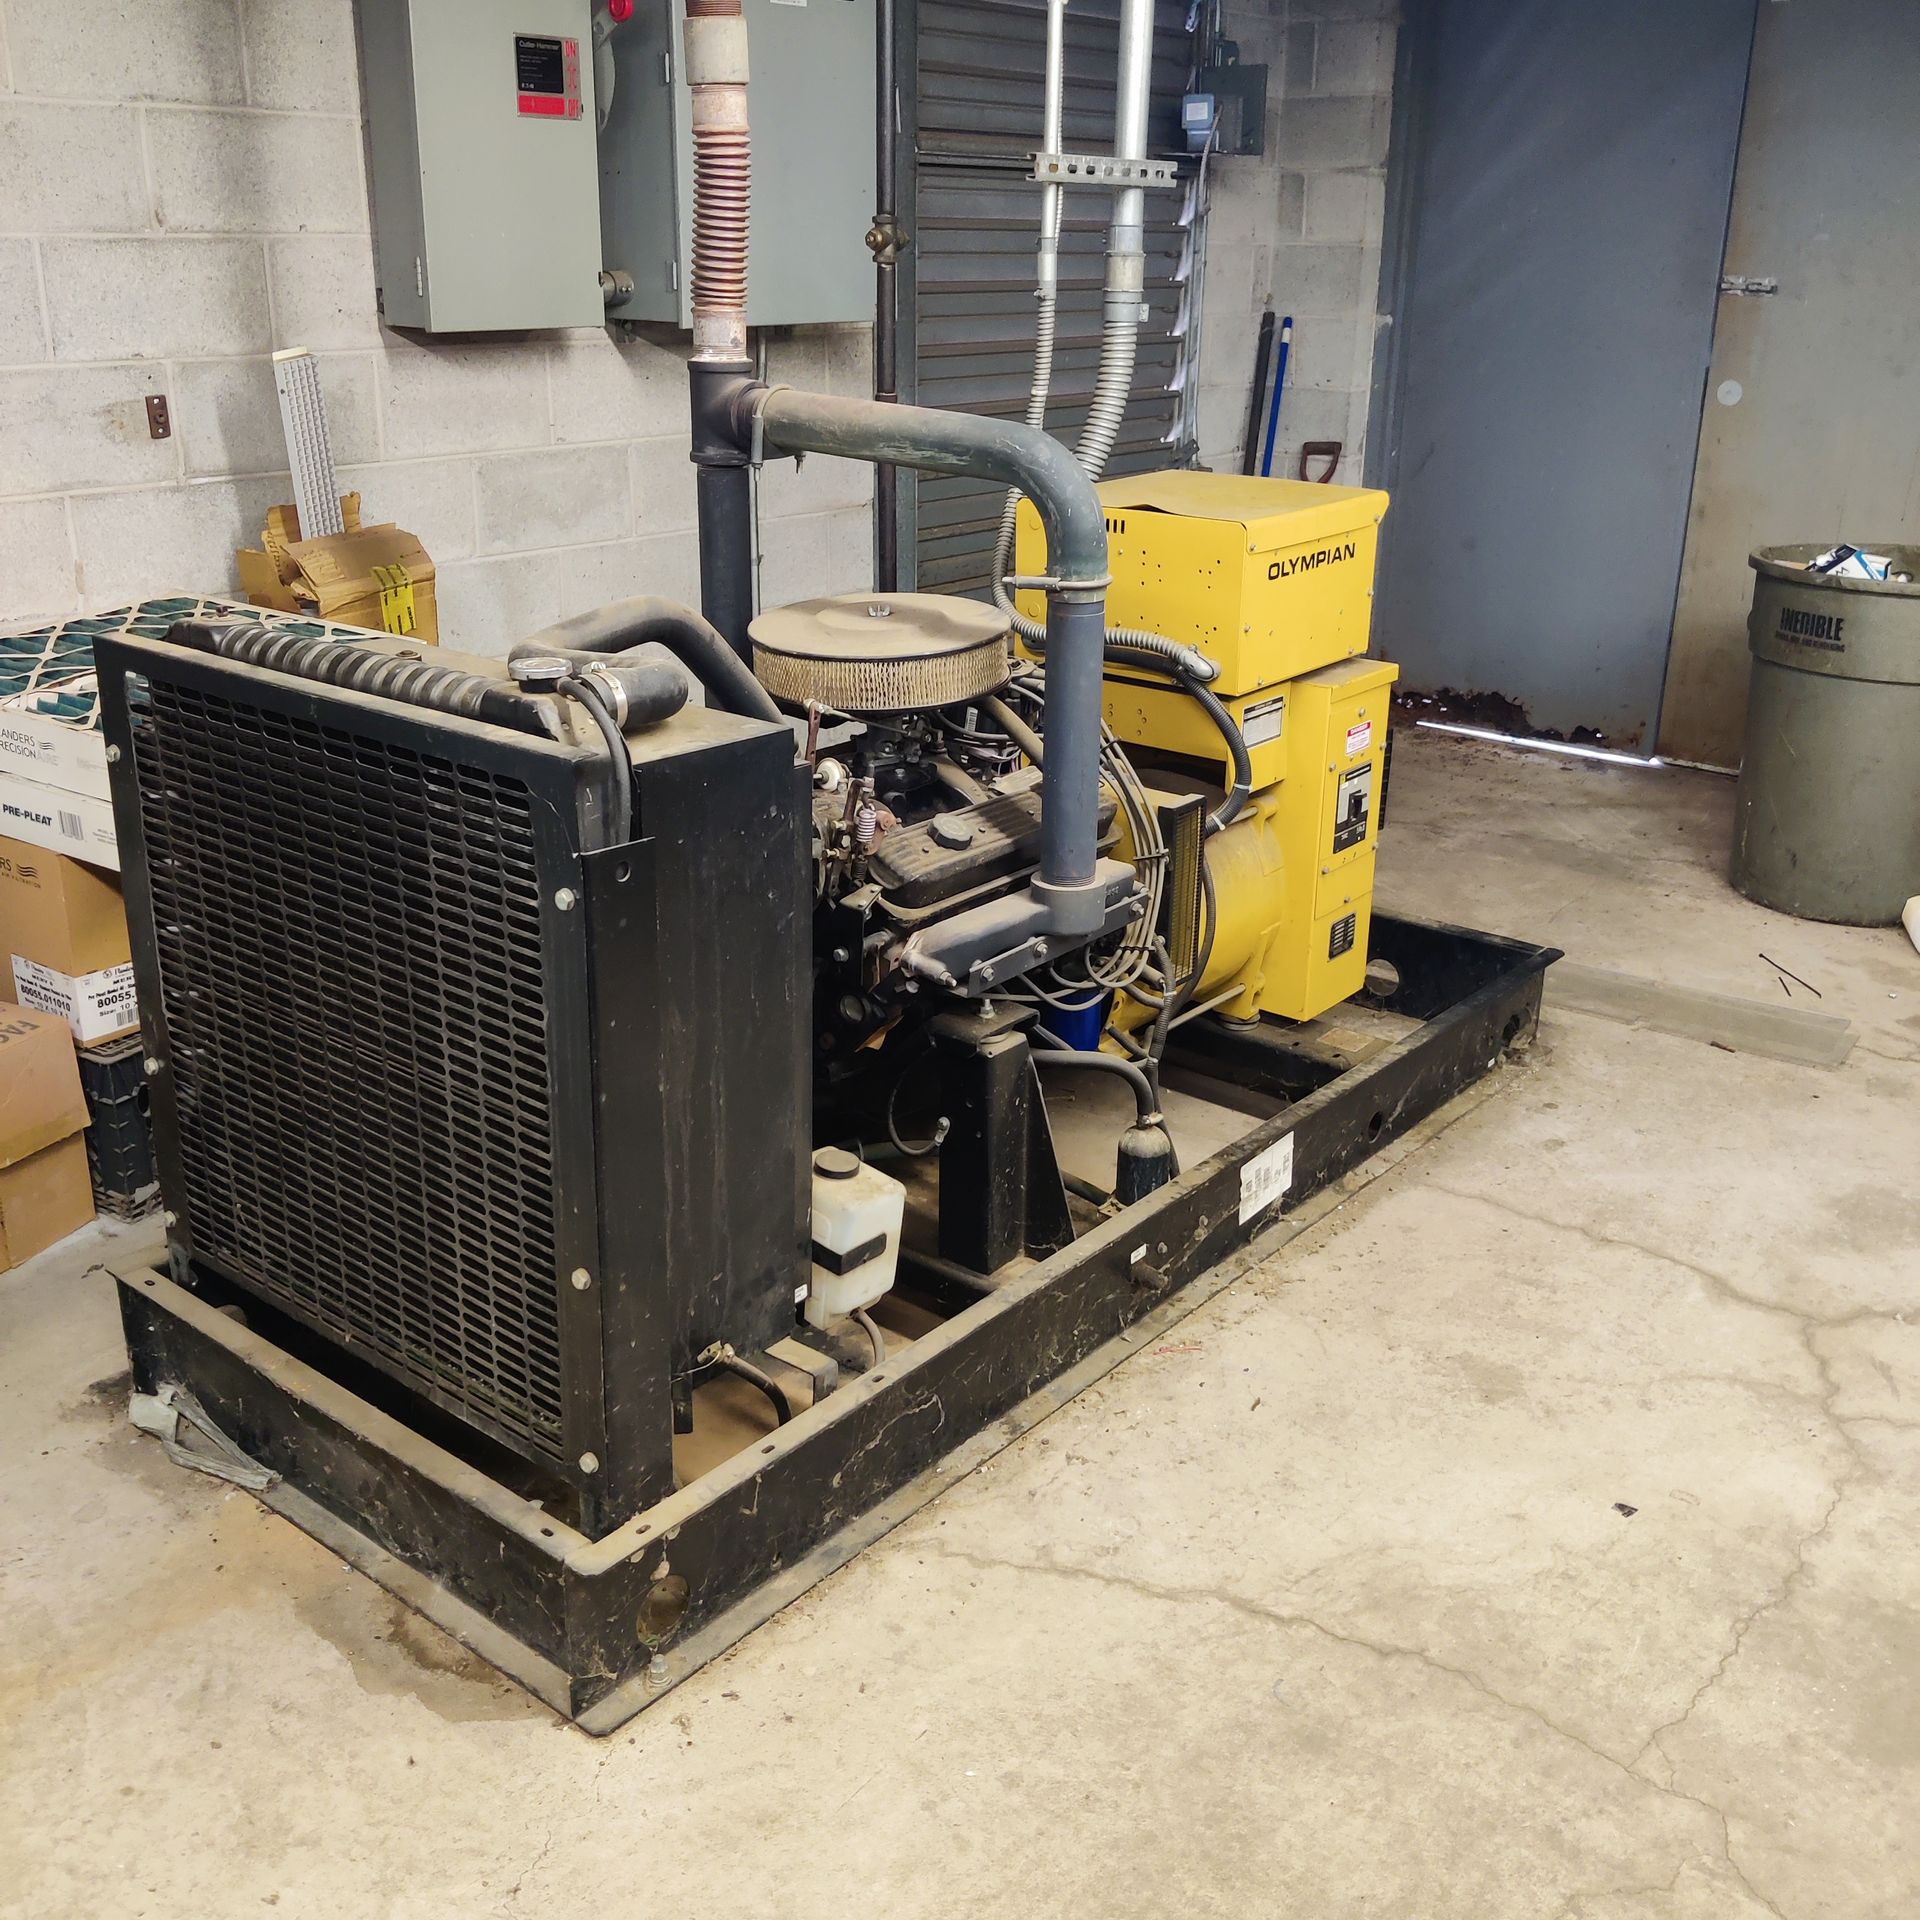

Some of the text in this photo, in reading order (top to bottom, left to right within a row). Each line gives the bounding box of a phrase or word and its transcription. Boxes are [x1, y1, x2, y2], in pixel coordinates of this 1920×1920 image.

[1268, 542, 1355, 581] OLYMPIAN
[1780, 607, 1845, 641] INEDIBLE
[2, 803, 53, 826] PRE-PLEAT
